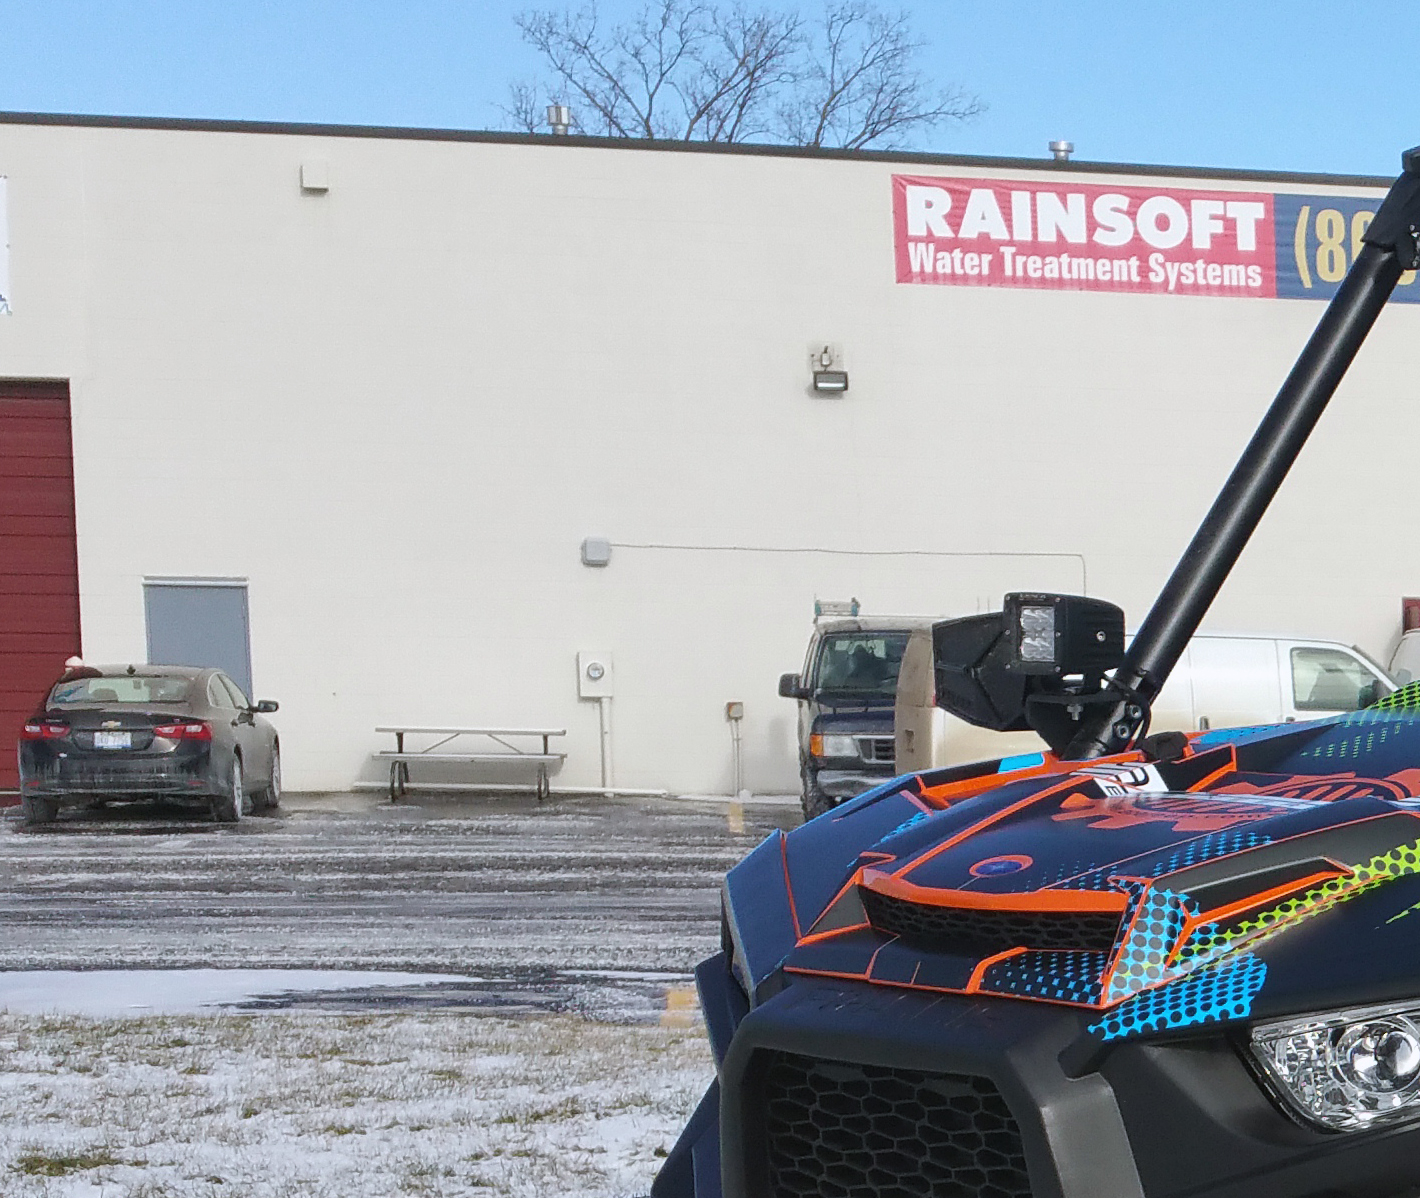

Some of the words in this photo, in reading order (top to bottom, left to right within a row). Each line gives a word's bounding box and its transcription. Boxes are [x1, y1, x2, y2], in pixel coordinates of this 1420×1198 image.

[905, 186, 1264, 251] RAINSOFT
[909, 243, 994, 279] Water
[1001, 247, 1140, 284] Treatment
[1147, 257, 1262, 289] Systems
